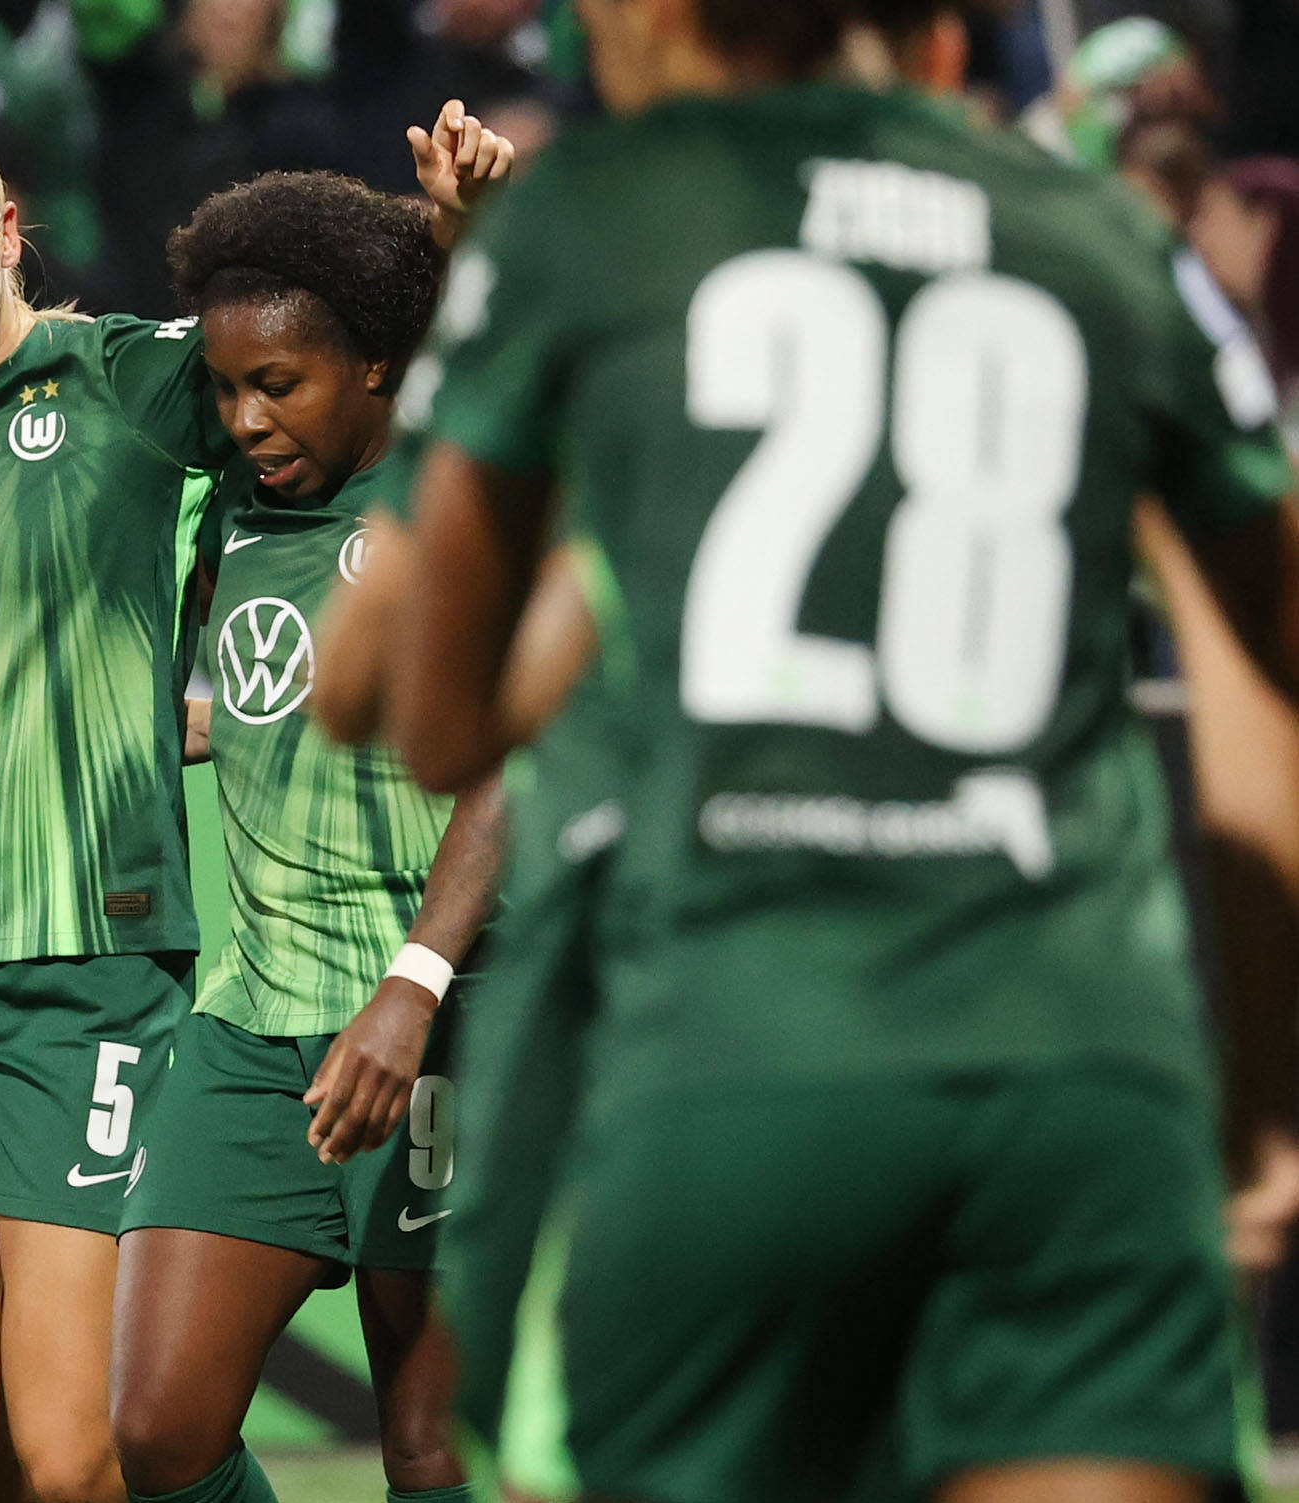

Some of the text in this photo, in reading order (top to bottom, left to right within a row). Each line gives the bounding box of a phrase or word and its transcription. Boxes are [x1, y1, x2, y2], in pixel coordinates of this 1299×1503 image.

[682, 247, 1089, 755] 28
[86, 1040, 142, 1157] 5
[408, 1074, 454, 1191] 9
